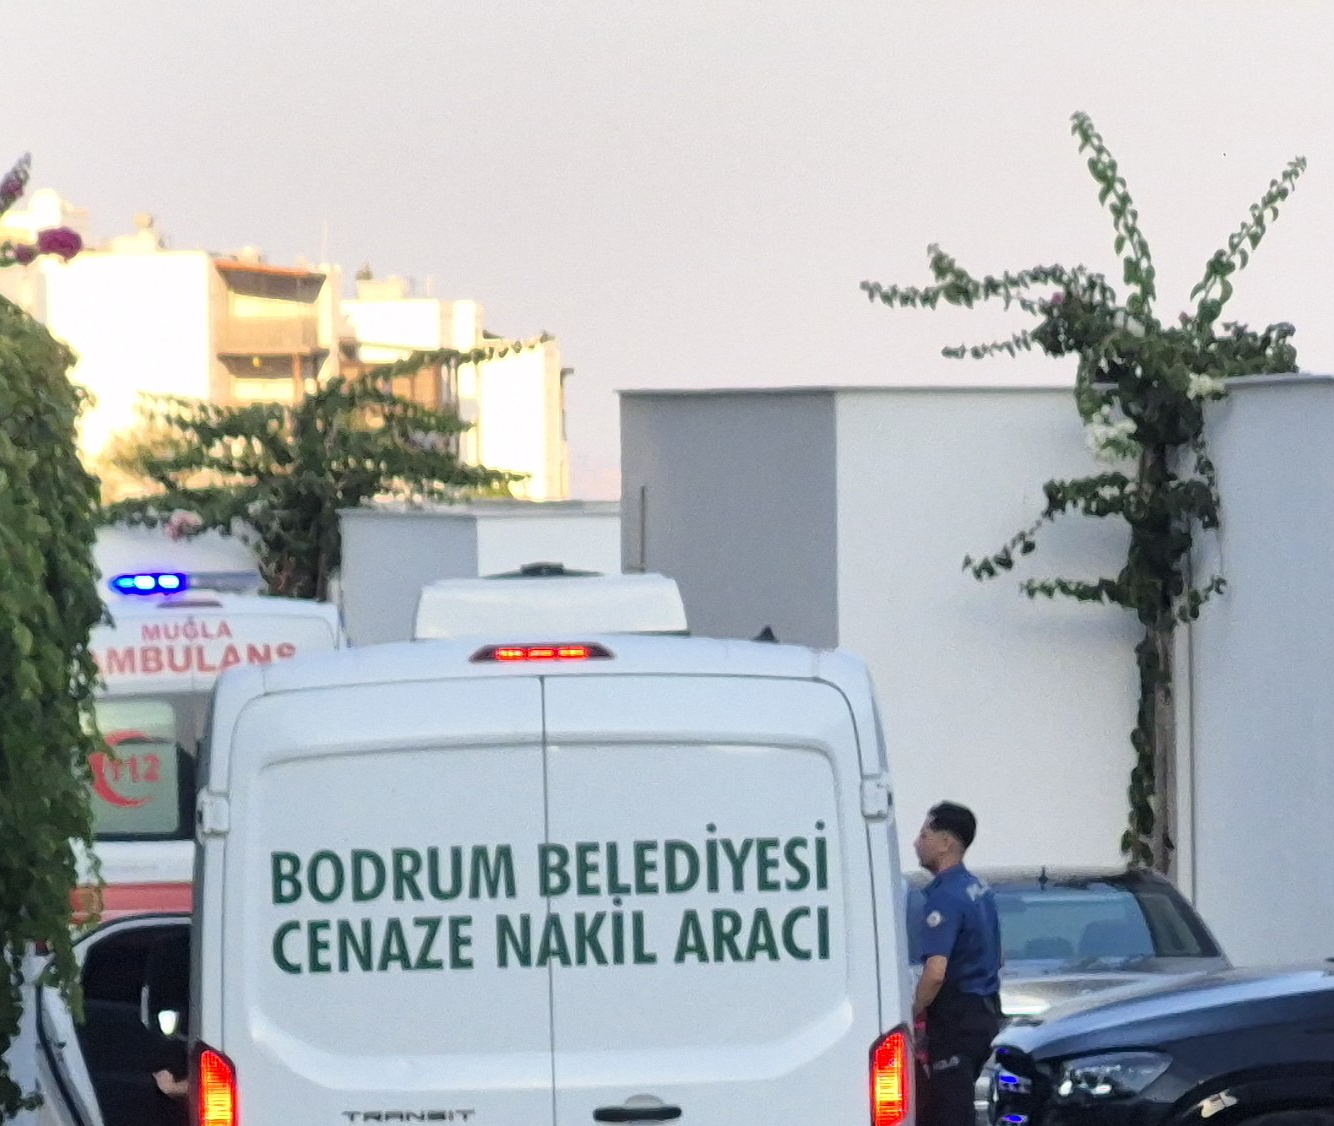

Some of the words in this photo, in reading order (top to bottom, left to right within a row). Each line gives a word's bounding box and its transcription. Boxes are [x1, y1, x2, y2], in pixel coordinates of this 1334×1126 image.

[141, 616, 233, 640] MUĞLA
[270, 844, 517, 905] BODRUM
[538, 821, 829, 898] BELEDİYESİ
[272, 915, 475, 975] CENAZE
[496, 896, 658, 969] NAKİL
[674, 906, 831, 964] ARACI
[341, 1108, 475, 1122] TRANSIT
